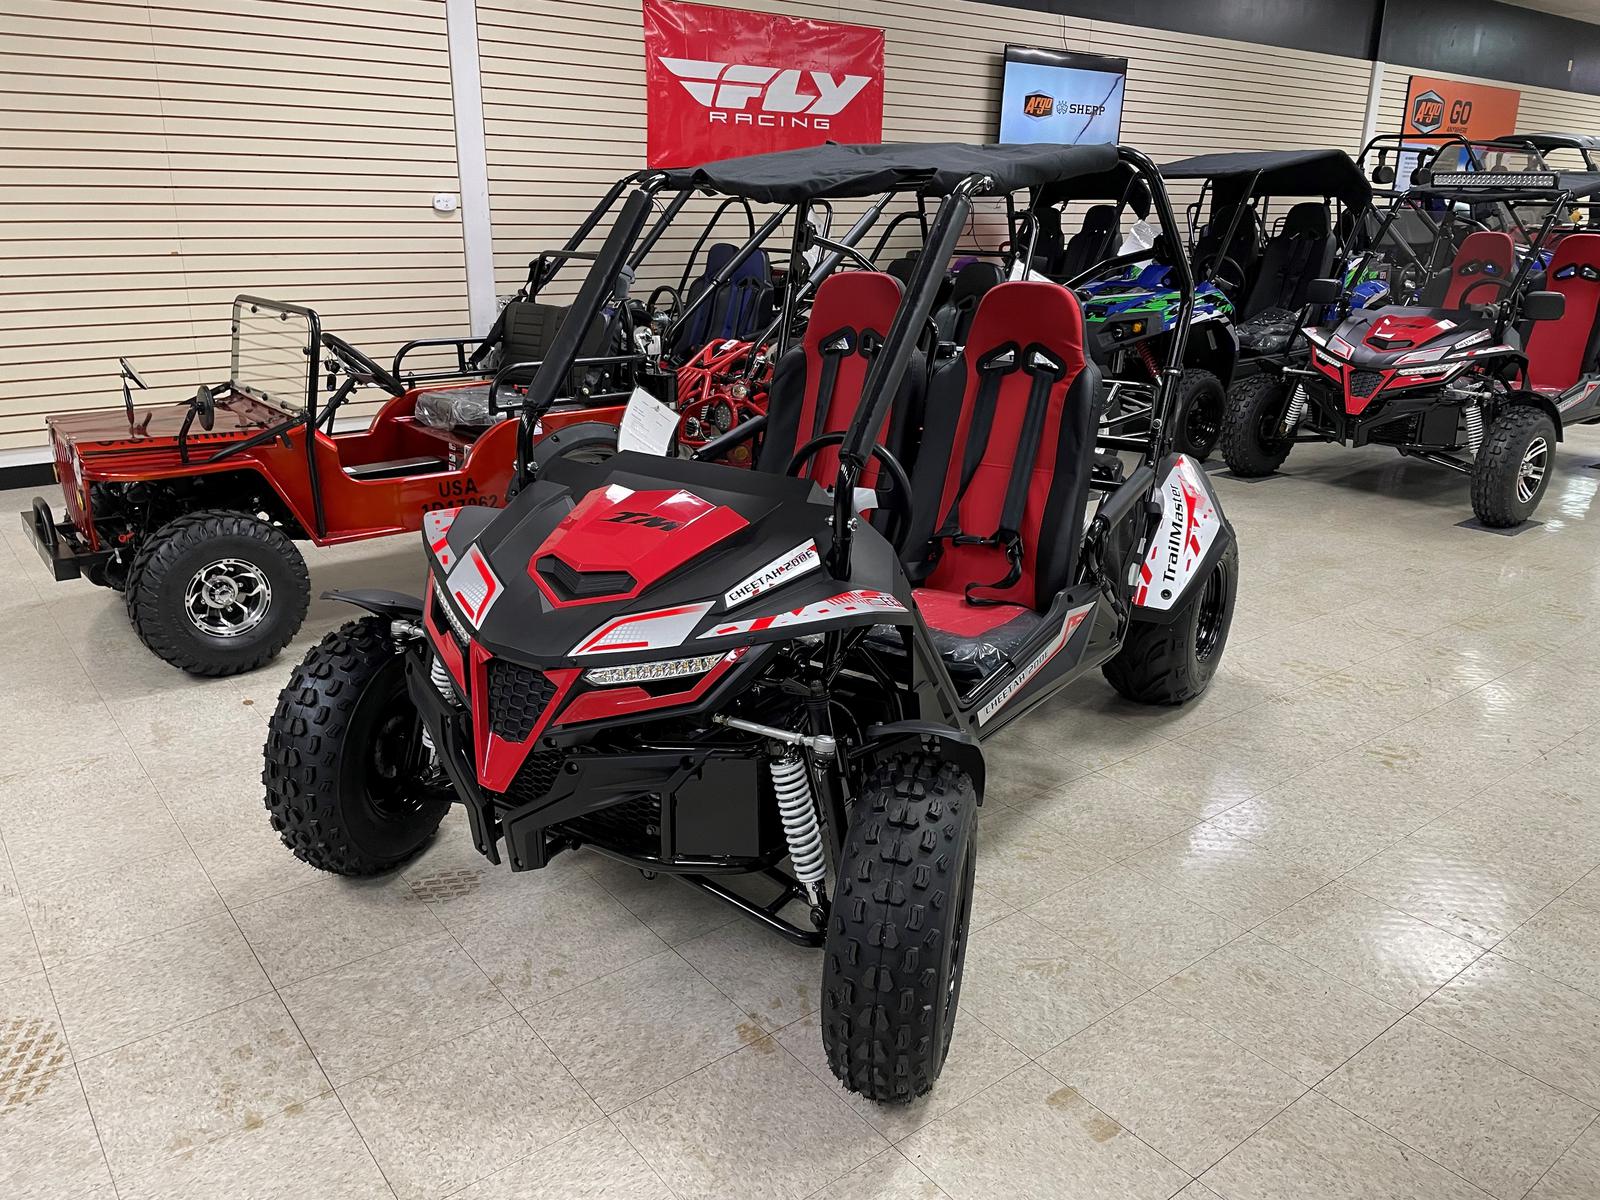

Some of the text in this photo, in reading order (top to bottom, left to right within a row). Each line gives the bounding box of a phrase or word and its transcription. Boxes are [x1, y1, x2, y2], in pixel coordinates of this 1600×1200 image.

[714, 64, 873, 116] FLY
[1024, 96, 1054, 115] Argo
[1068, 103, 1106, 116] SHERP
[1415, 101, 1443, 123] Argo
[1449, 100, 1473, 125] GO
[708, 111, 831, 130] RACING
[438, 478, 479, 498] USA
[1162, 483, 1185, 582] TrailMaster
[728, 566, 782, 602] CHEETAH
[985, 673, 1026, 715] CHEETAH
